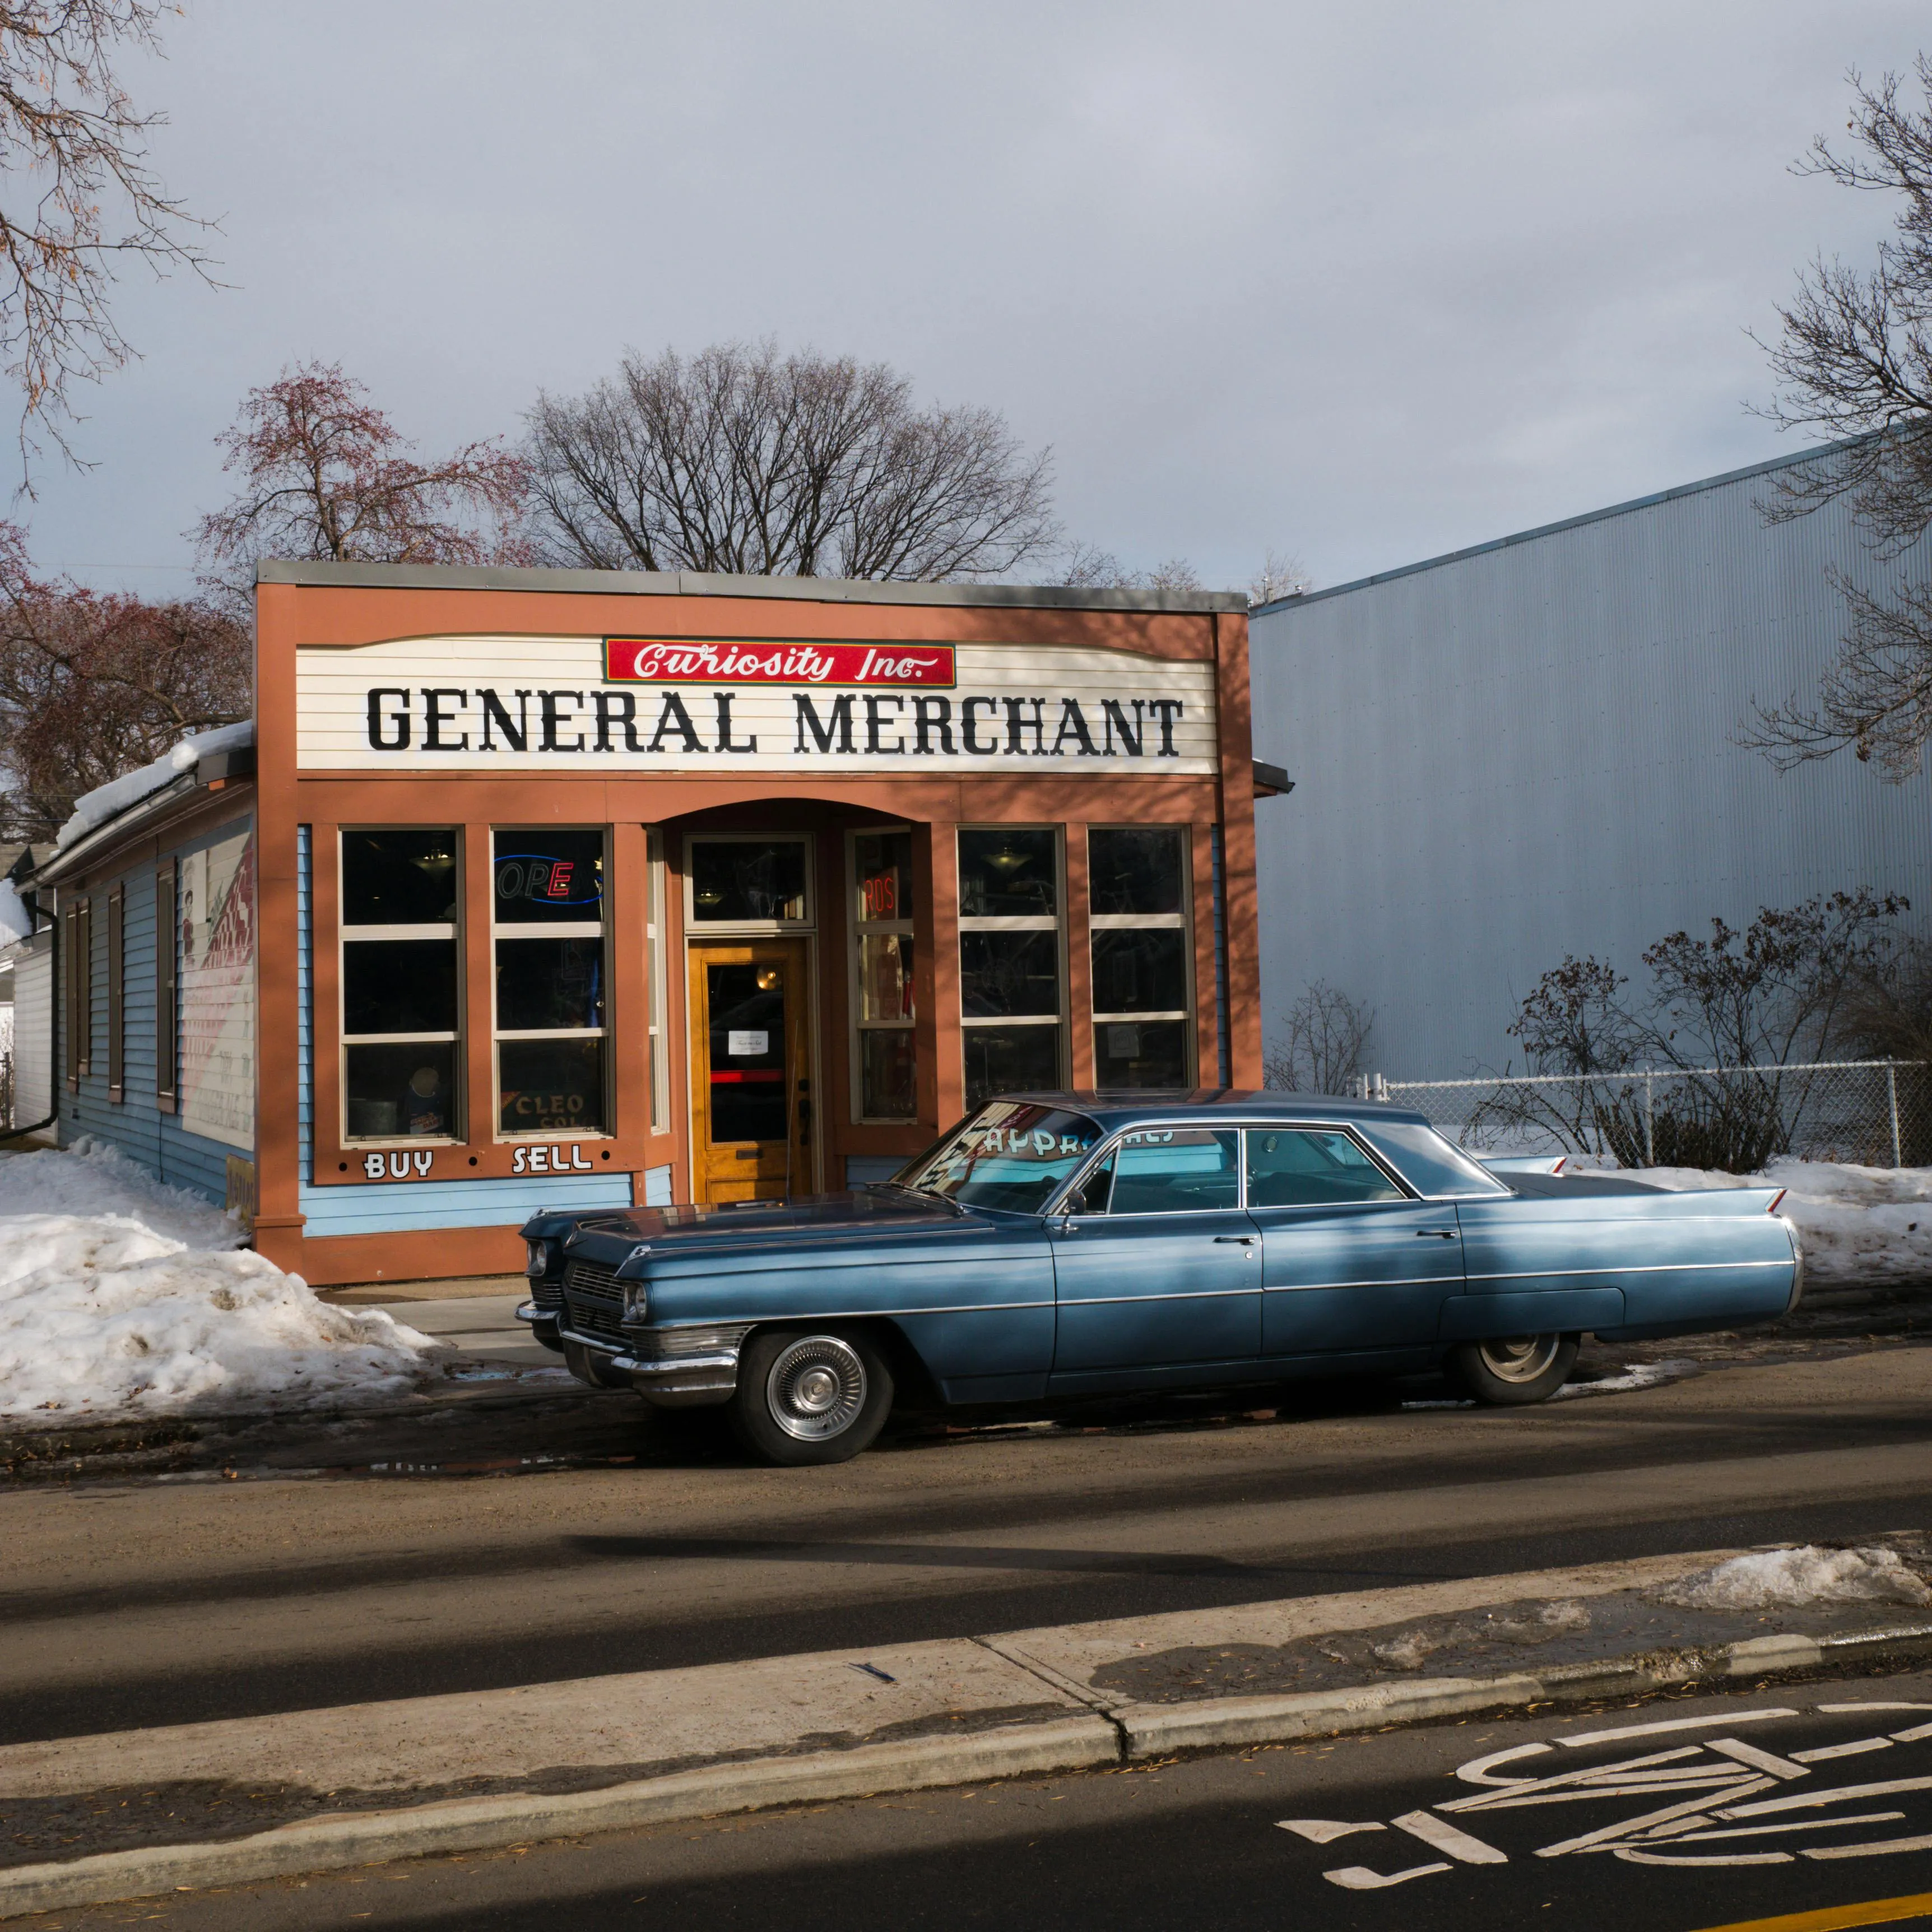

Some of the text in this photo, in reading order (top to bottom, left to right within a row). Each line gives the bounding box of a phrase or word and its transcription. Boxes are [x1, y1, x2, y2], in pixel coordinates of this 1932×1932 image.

[634, 643, 939, 682] Curiosity Inc.
[366, 688, 1184, 757] GENERAL MERCHANT
[497, 862, 592, 899] OPE
[515, 1094, 583, 1115] CLEO
[540, 1116, 596, 1128] COL
[362, 1151, 433, 1179] BUY
[512, 1145, 593, 1173] SELL
